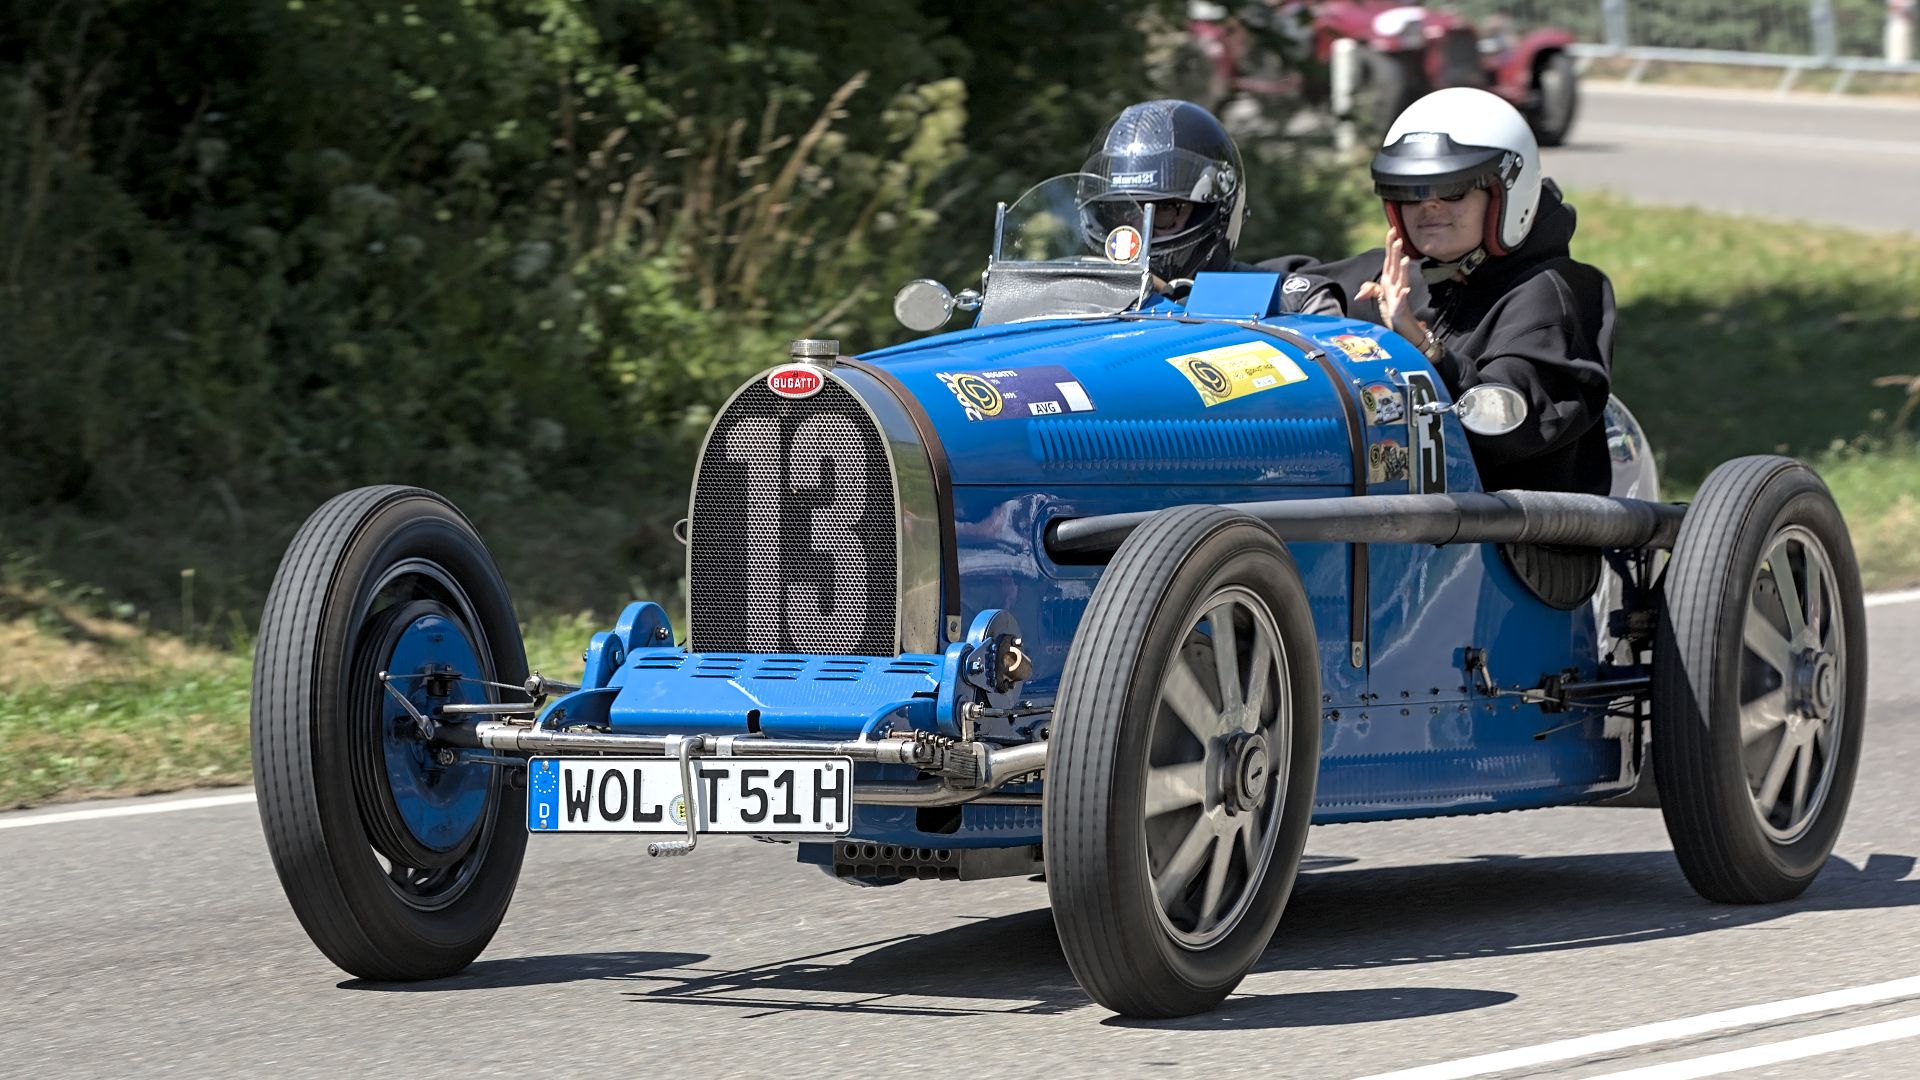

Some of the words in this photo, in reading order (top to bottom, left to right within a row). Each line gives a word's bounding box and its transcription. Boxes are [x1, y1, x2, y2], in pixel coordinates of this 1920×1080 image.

[773, 377, 816, 388] BUGATTI
[1036, 402, 1056, 414] AVG
[725, 411, 869, 653] 13
[564, 768, 663, 823] WOL
[539, 802, 550, 819] D
